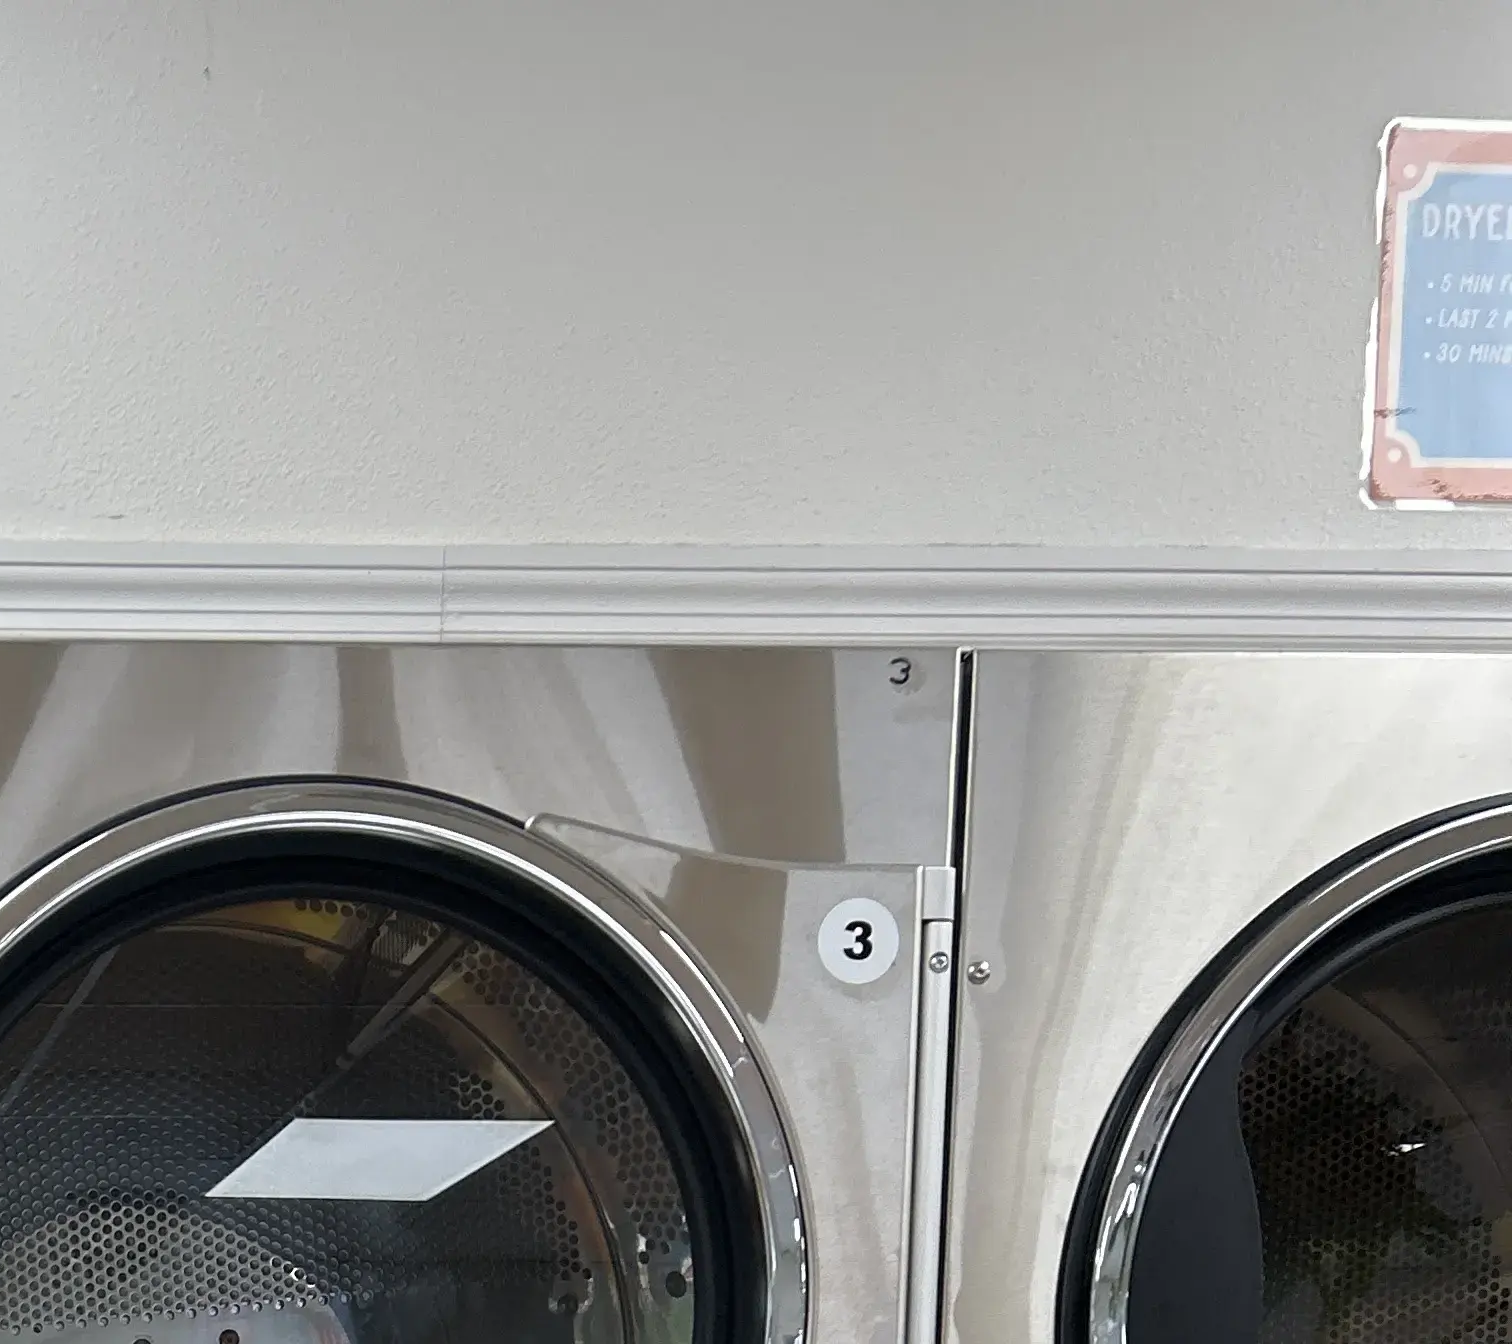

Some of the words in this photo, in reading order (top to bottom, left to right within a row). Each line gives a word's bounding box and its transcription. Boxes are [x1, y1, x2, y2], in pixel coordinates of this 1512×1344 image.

[1460, 273, 1495, 294] MIN
[1438, 308, 1481, 329] LAST
[1485, 308, 1499, 328] 2
[1436, 342, 1461, 363] 30
[889, 657, 912, 685] 3
[843, 920, 873, 961] 3
